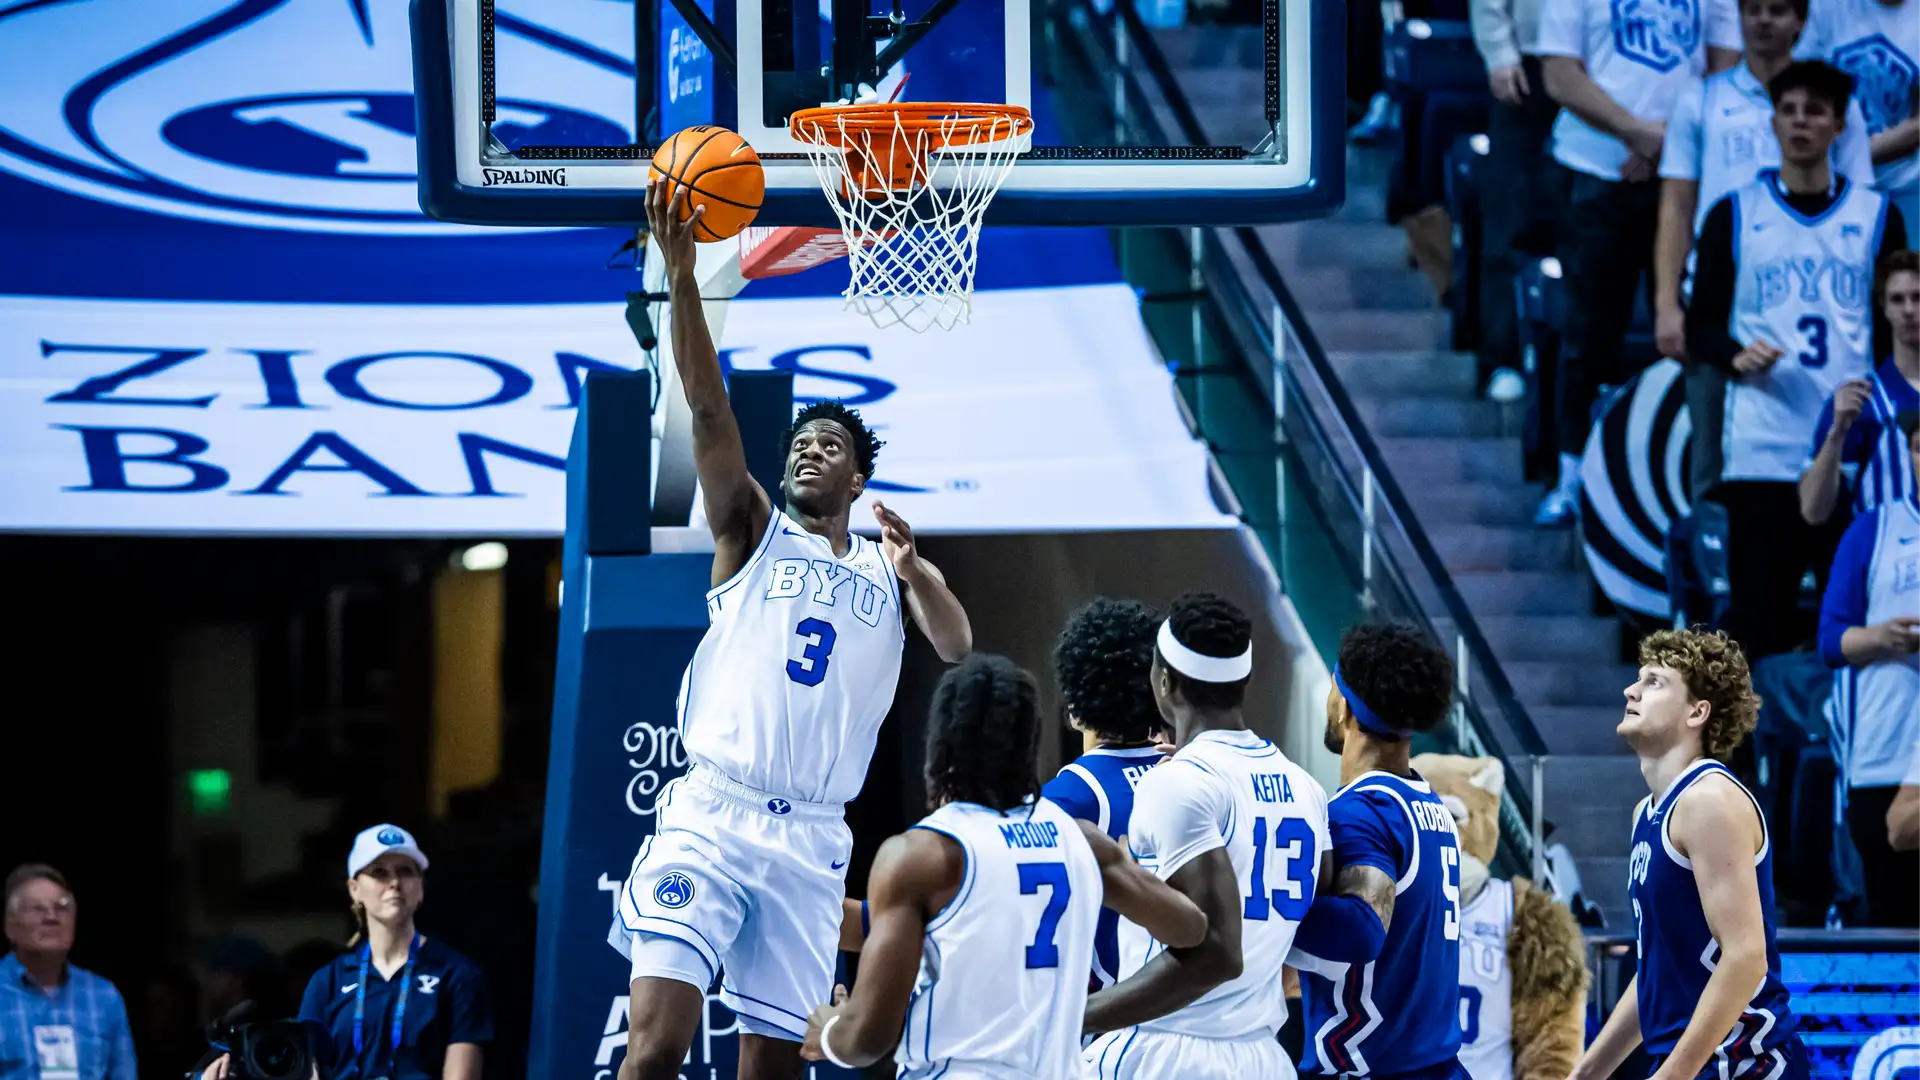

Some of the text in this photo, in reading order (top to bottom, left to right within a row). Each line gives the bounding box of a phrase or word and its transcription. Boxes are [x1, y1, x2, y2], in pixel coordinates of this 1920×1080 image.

[482, 168, 566, 187] SPALDING
[40, 338, 897, 407] ZIOS
[1798, 313, 1828, 369] 3
[764, 557, 888, 628] BYU
[785, 616, 838, 688] 3
[1250, 773, 1295, 803] KEITA
[998, 820, 1060, 849] MBOUP
[1243, 816, 1316, 922] 13
[1016, 862, 1072, 969] 7
[1440, 846, 1460, 941] 5
[417, 974, 441, 994] Y
